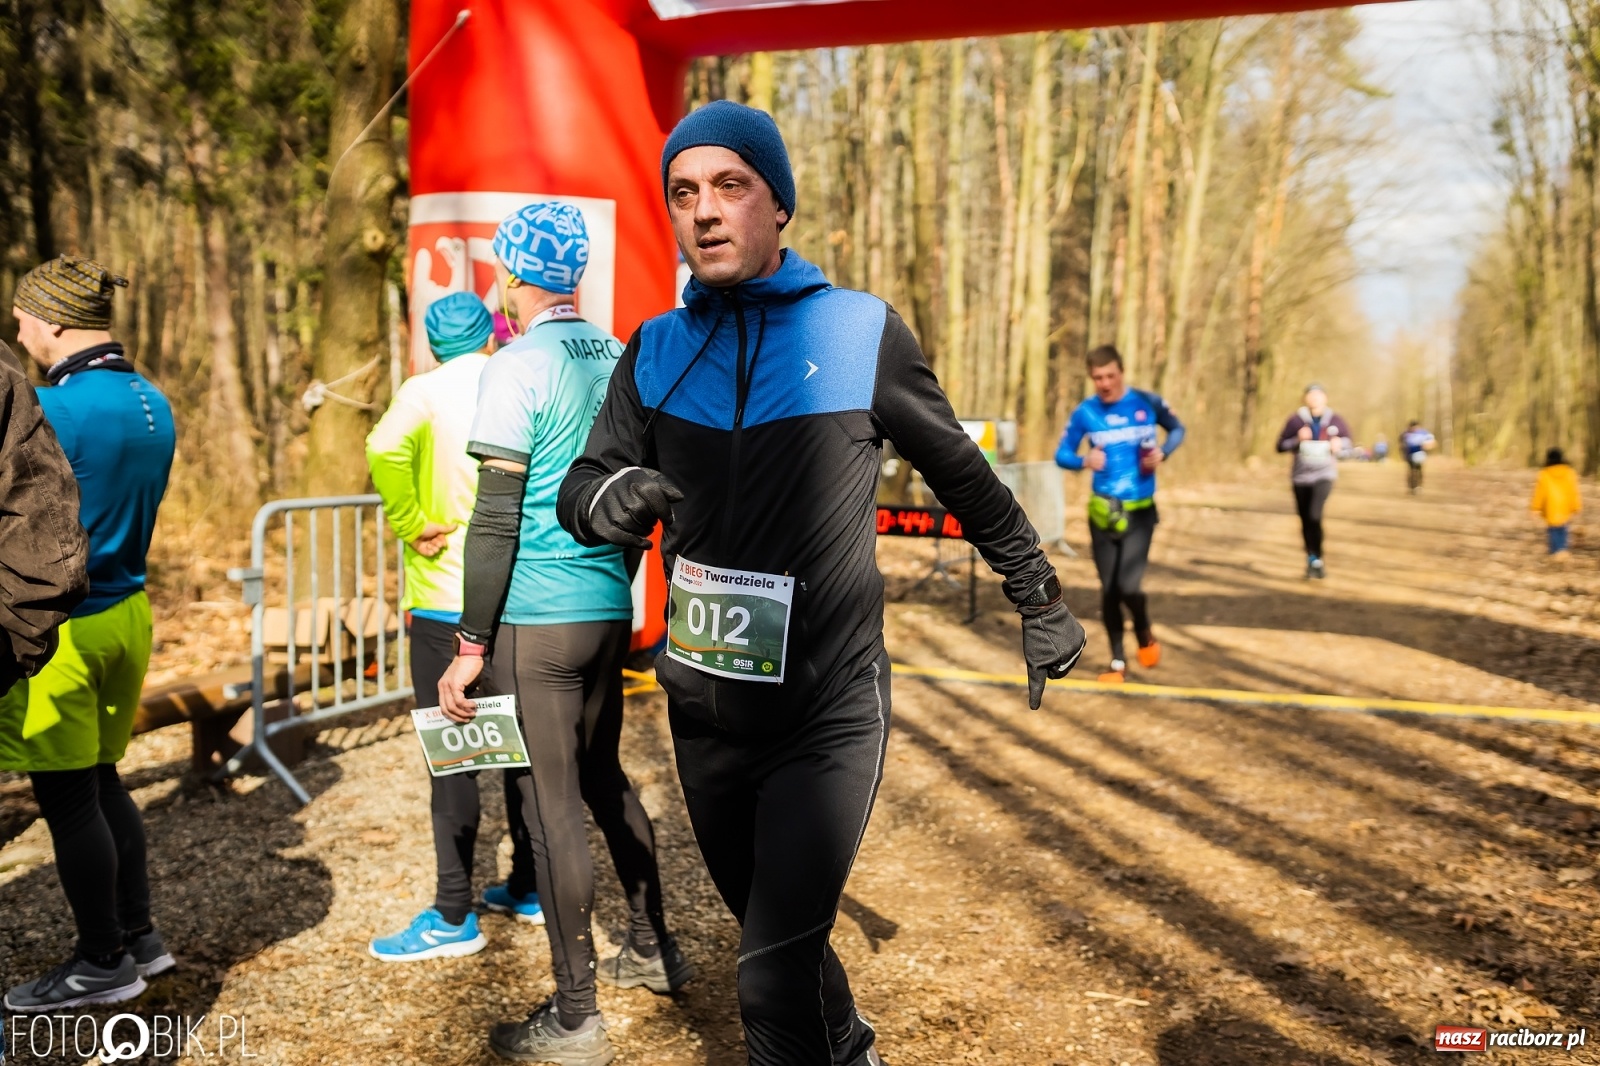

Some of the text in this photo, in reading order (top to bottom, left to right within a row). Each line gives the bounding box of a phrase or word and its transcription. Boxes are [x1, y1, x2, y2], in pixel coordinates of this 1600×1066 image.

[680, 562, 775, 590] X BIEG Twardziela
[687, 597, 751, 646] 012
[441, 721, 504, 752] 006
